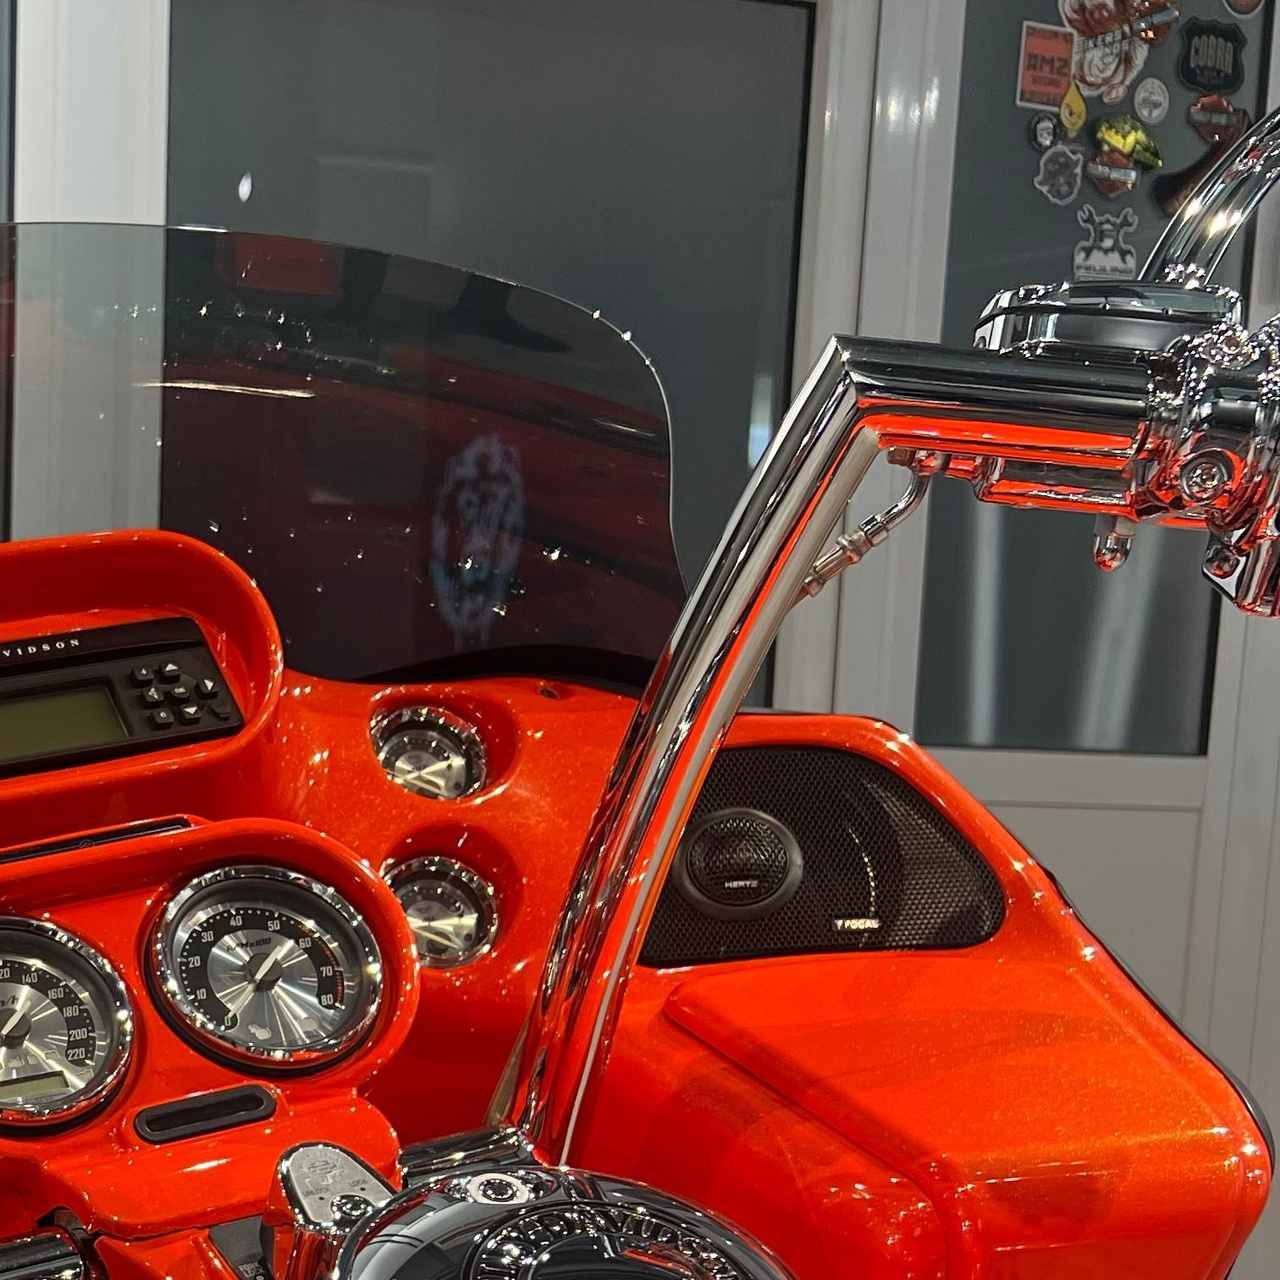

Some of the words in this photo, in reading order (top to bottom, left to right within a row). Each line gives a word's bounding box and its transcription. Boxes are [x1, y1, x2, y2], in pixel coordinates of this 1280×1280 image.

[229, 915, 243, 928] 40
[267, 920, 281, 931] 50
[201, 931, 214, 943] 30
[299, 937, 312, 949] 60
[188, 956, 201, 968] 20
[320, 966, 333, 977] 70
[22, 972, 38, 984] 140
[48, 988, 64, 1000] 160
[197, 988, 207, 1000] 10
[321, 994, 333, 1005] 80
[63, 1006, 79, 1018] 180
[69, 1028, 88, 1041] 200
[67, 1048, 86, 1060] 220
